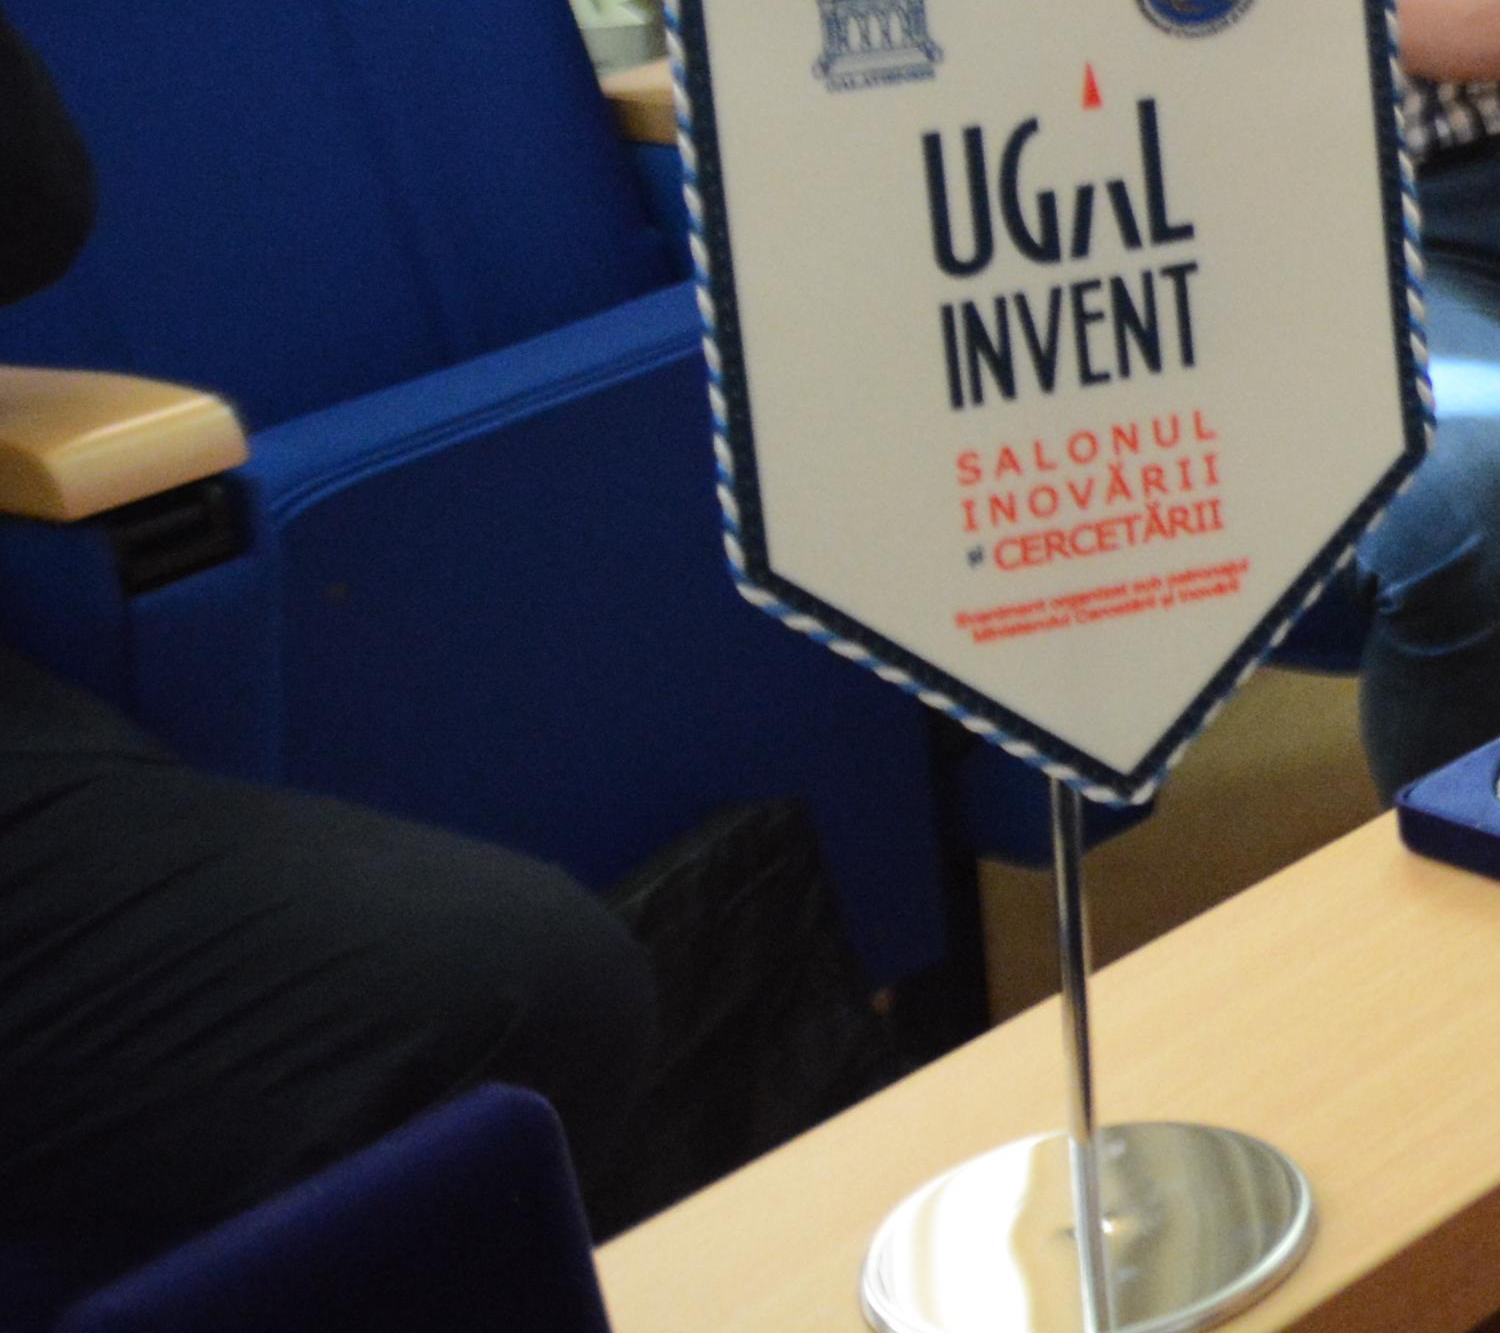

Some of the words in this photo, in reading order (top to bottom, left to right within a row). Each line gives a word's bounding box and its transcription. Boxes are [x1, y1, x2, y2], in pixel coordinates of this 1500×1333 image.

[920, 95, 1196, 278] UGAL
[938, 261, 1199, 410] INVENT
[956, 410, 1218, 487] SALONUL
[961, 452, 1220, 533] INOVĂRII
[993, 496, 1225, 572] CERCETĂRII
